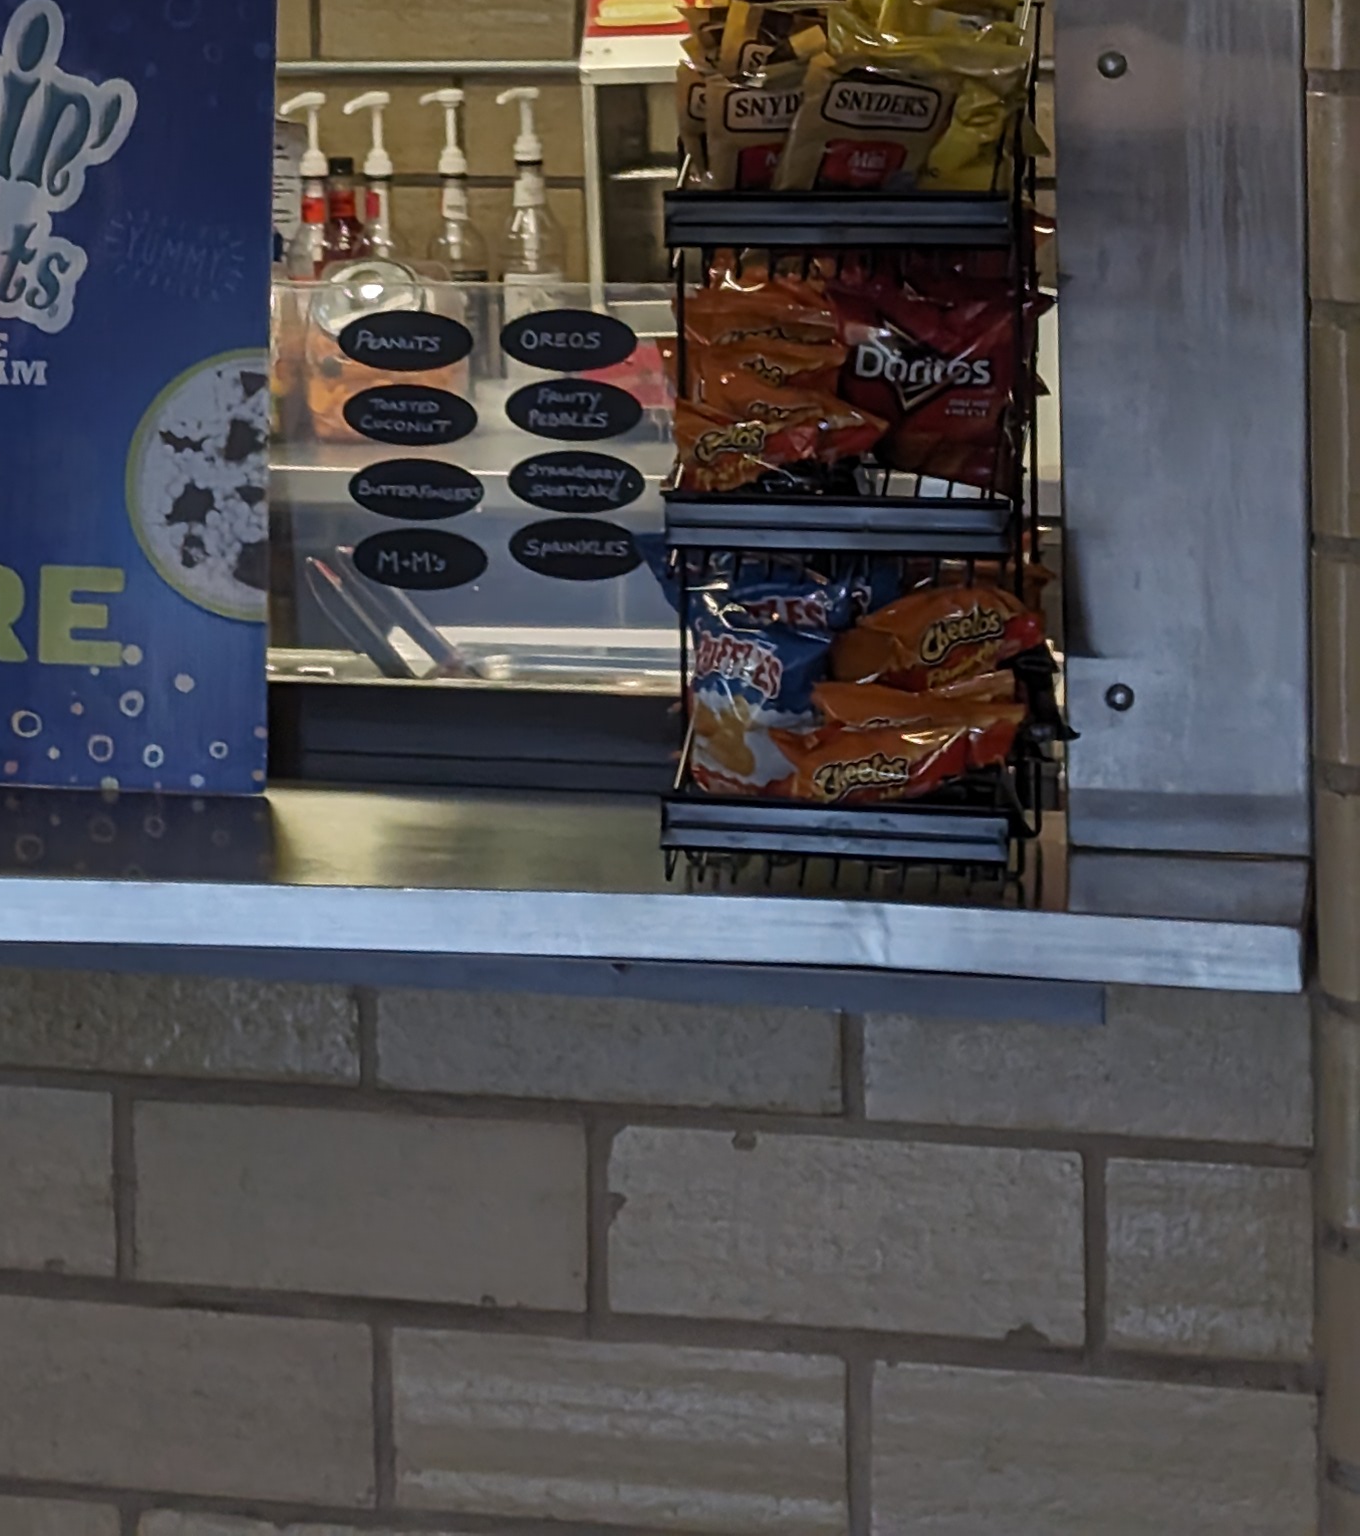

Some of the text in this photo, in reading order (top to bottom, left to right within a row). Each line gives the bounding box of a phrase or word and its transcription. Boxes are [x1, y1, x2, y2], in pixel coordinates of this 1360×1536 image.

[520, 330, 601, 349] OREOS
[855, 344, 990, 385] Doritos
[921, 609, 1003, 663] Cheetos
[814, 753, 909, 802] Cheetos
